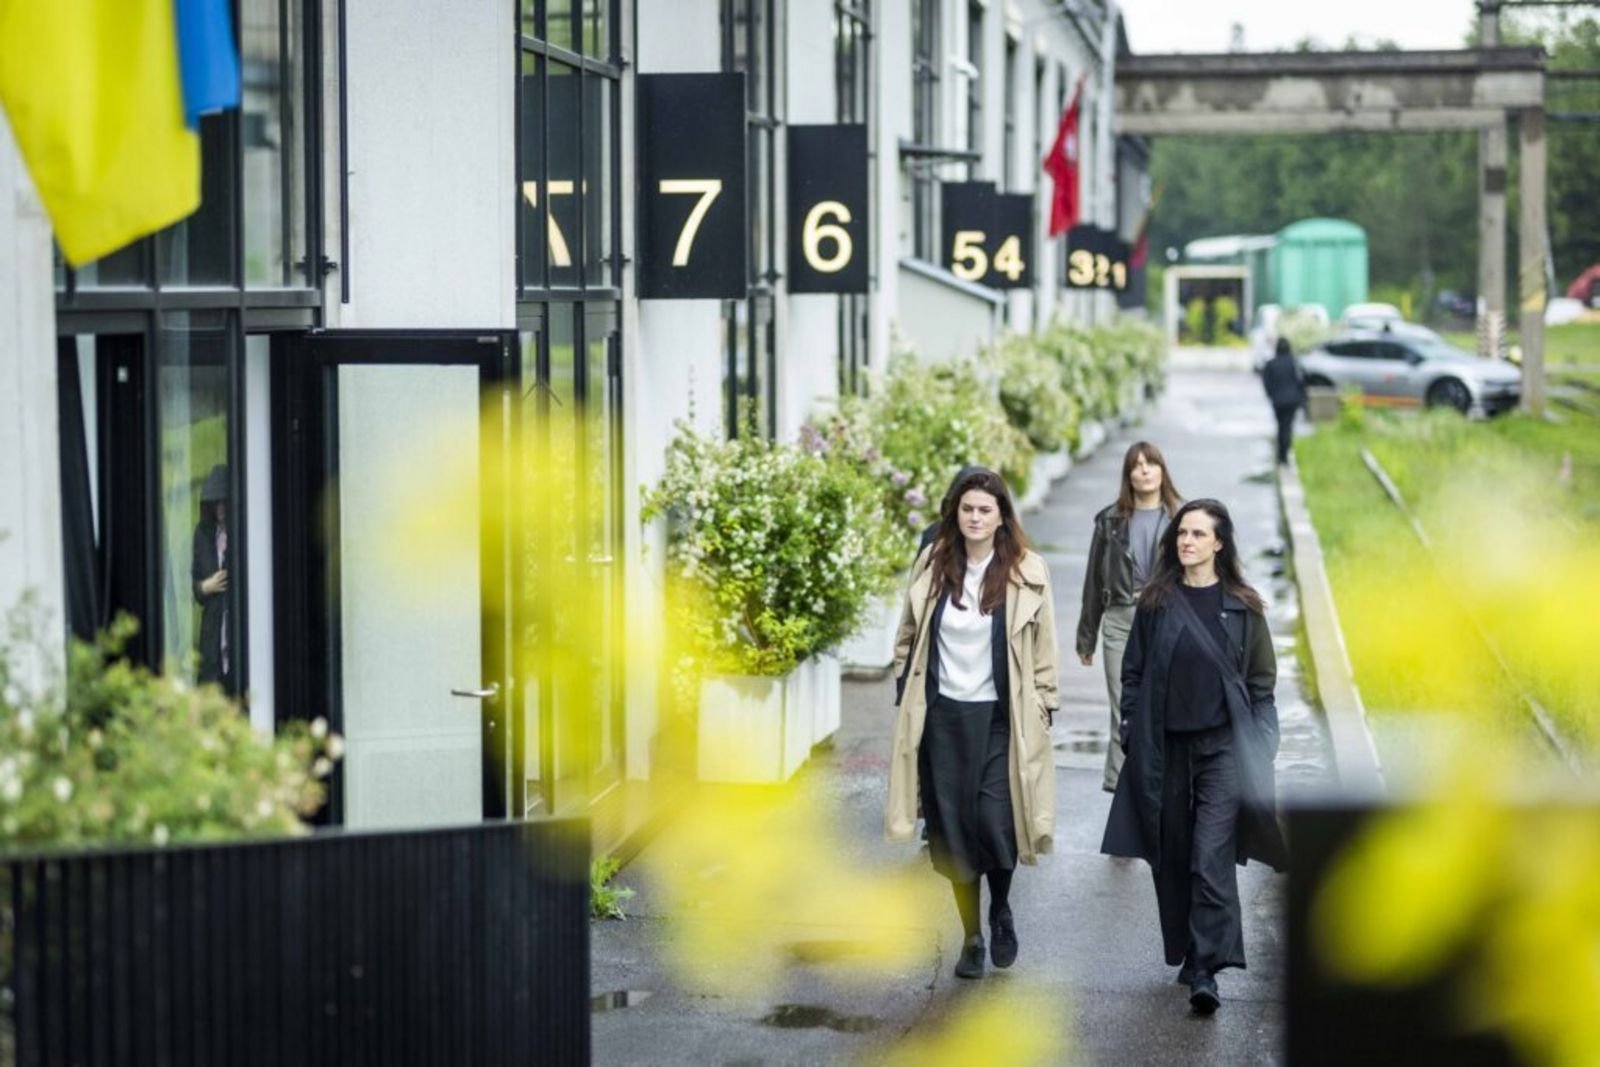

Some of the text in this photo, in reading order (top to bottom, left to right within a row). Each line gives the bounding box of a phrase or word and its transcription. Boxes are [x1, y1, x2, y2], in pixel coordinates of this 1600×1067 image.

[659, 179, 722, 267] 7
[802, 201, 852, 273] 6
[951, 230, 988, 281] 5
[994, 235, 1026, 281] 4
[1069, 249, 1094, 286] 3
[1111, 261, 1126, 289] 1
